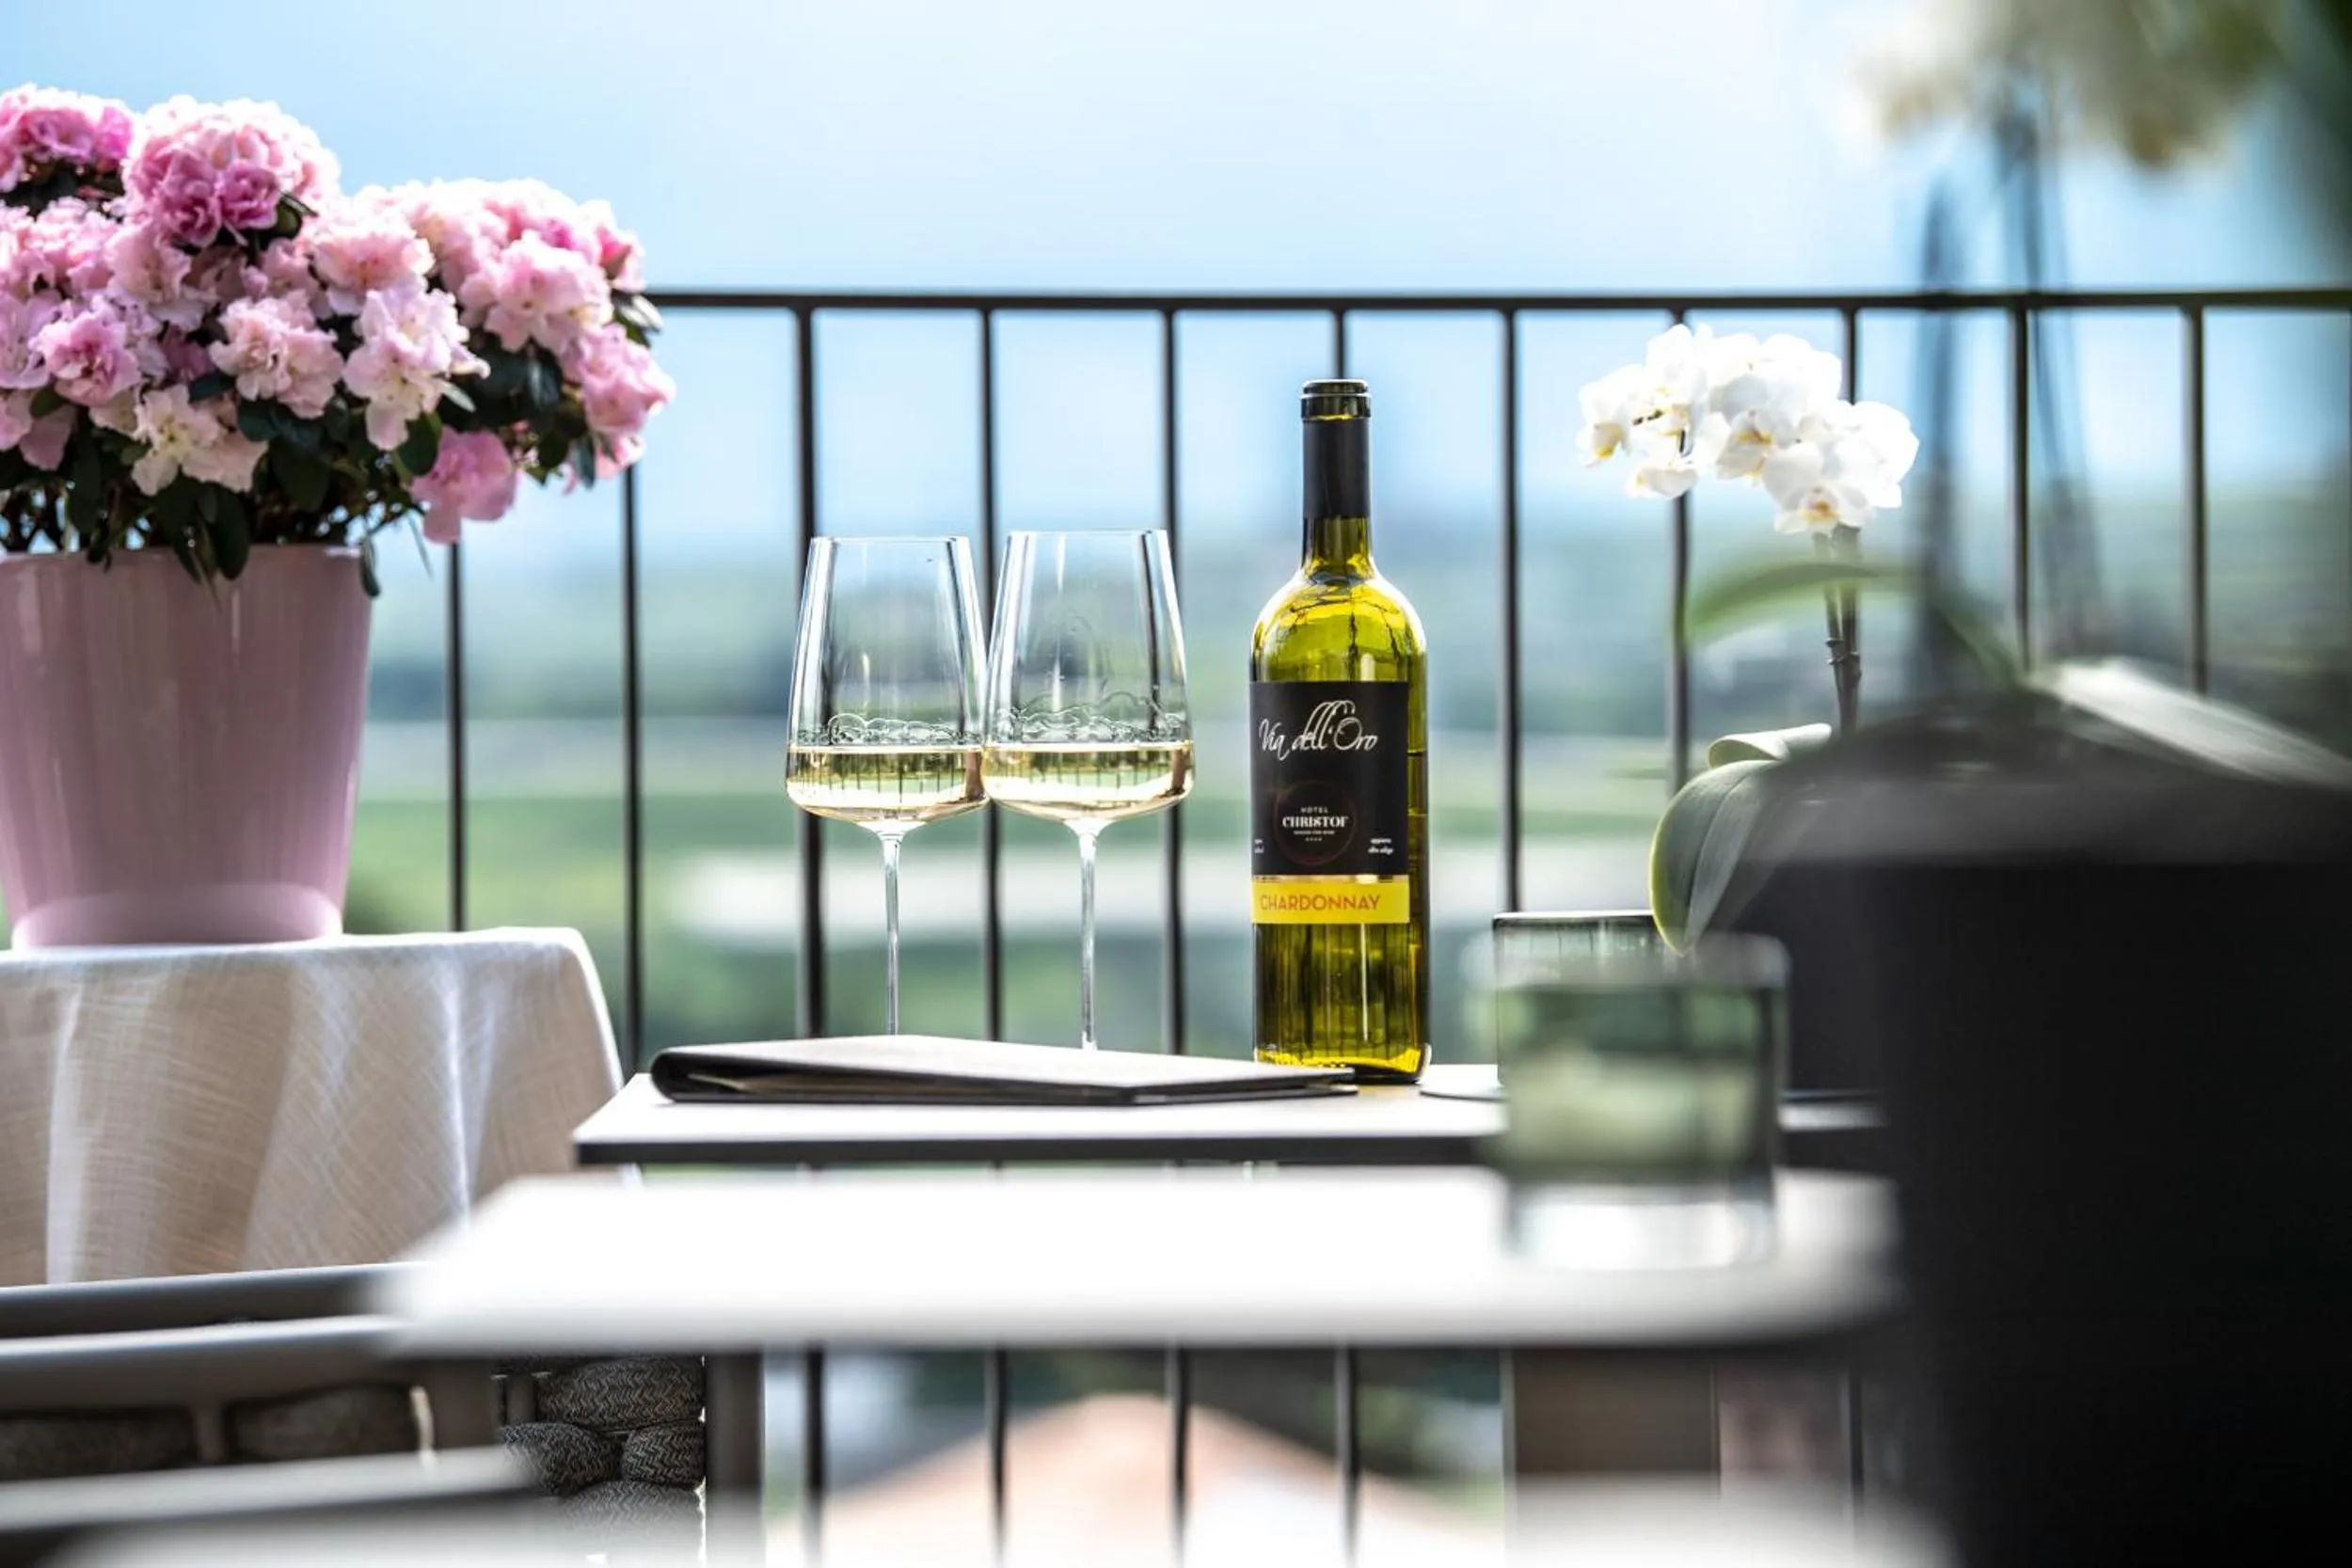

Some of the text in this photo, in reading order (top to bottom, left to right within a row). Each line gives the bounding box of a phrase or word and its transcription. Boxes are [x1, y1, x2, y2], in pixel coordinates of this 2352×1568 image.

[1259, 719, 1290, 761] Via
[1281, 816, 1349, 828] CHRISTOF
[1260, 895, 1380, 911] CHARDONNAY
